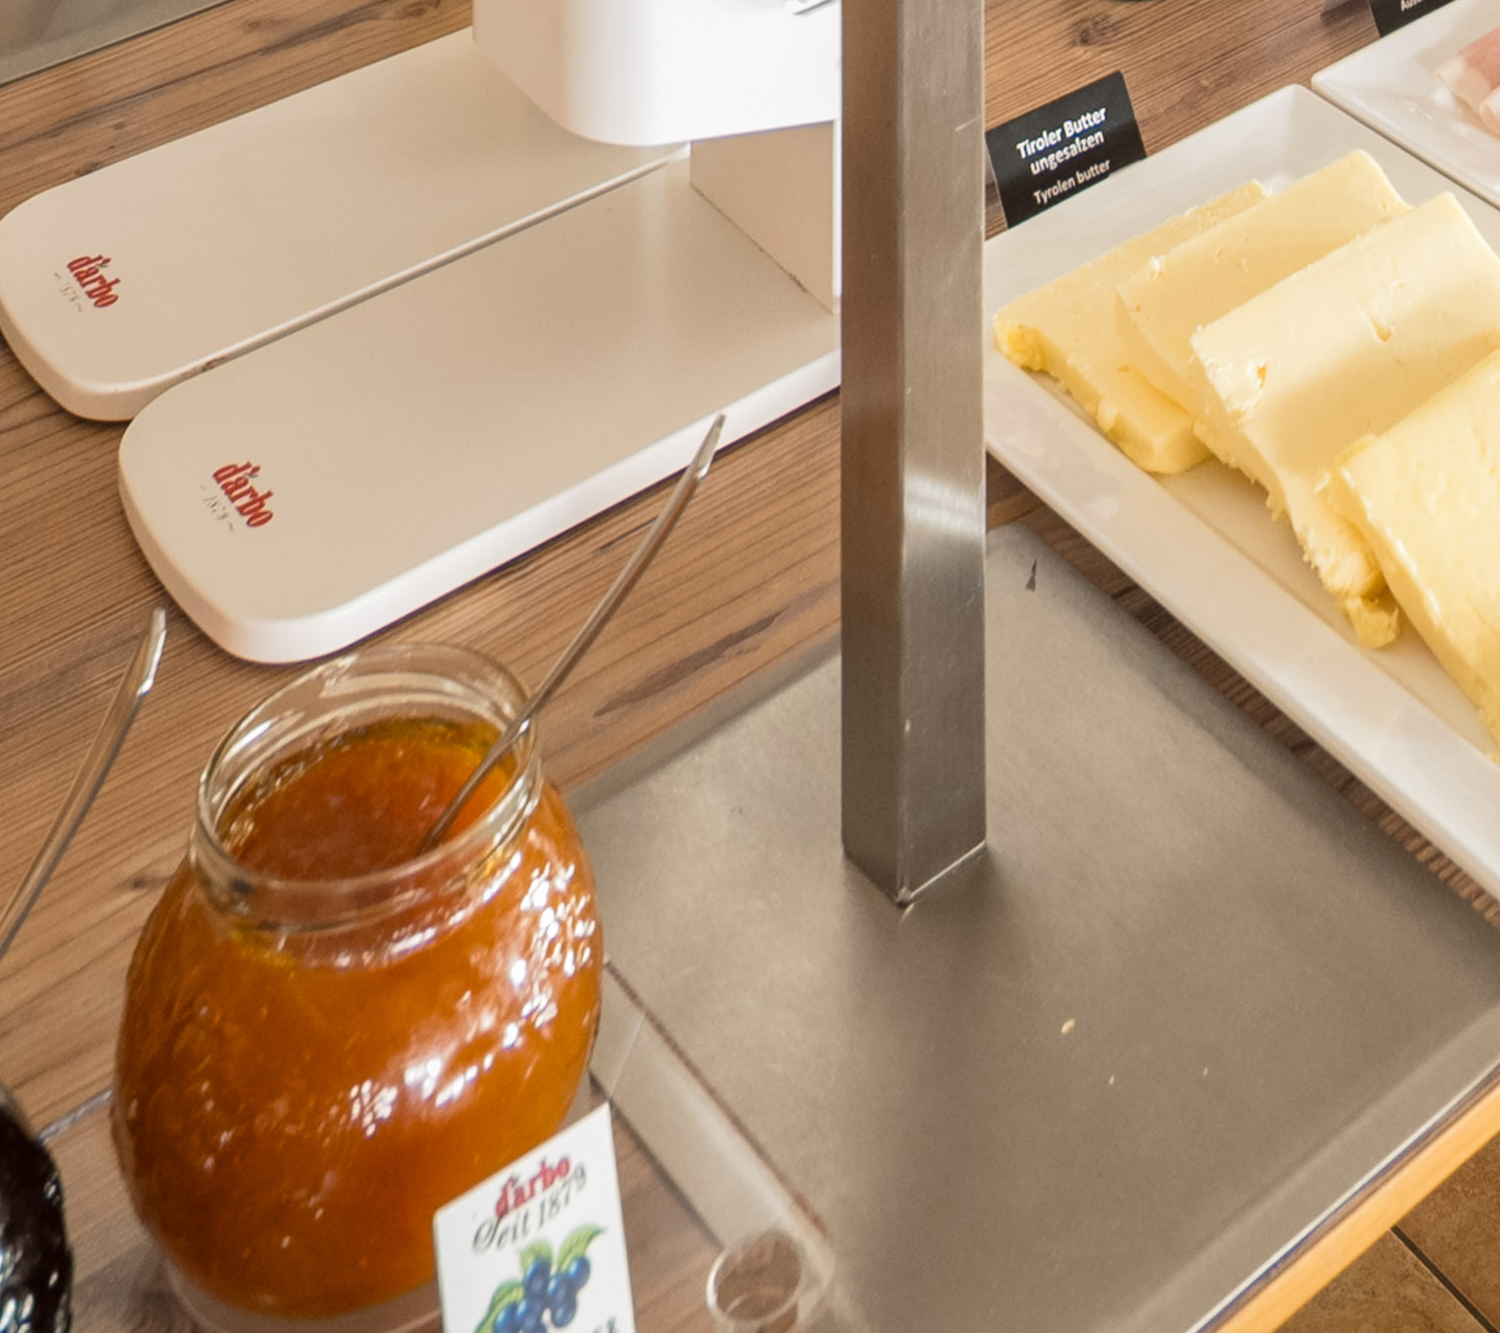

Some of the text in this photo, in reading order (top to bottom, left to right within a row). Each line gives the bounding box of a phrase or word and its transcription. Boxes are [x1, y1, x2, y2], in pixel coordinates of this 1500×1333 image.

[1015, 107, 1107, 160] Tiroler Butter
[1029, 130, 1106, 176] ungesalzen
[1032, 159, 1111, 205] Tyrolen butter
[471, 1161, 587, 1256] Seit 1879
